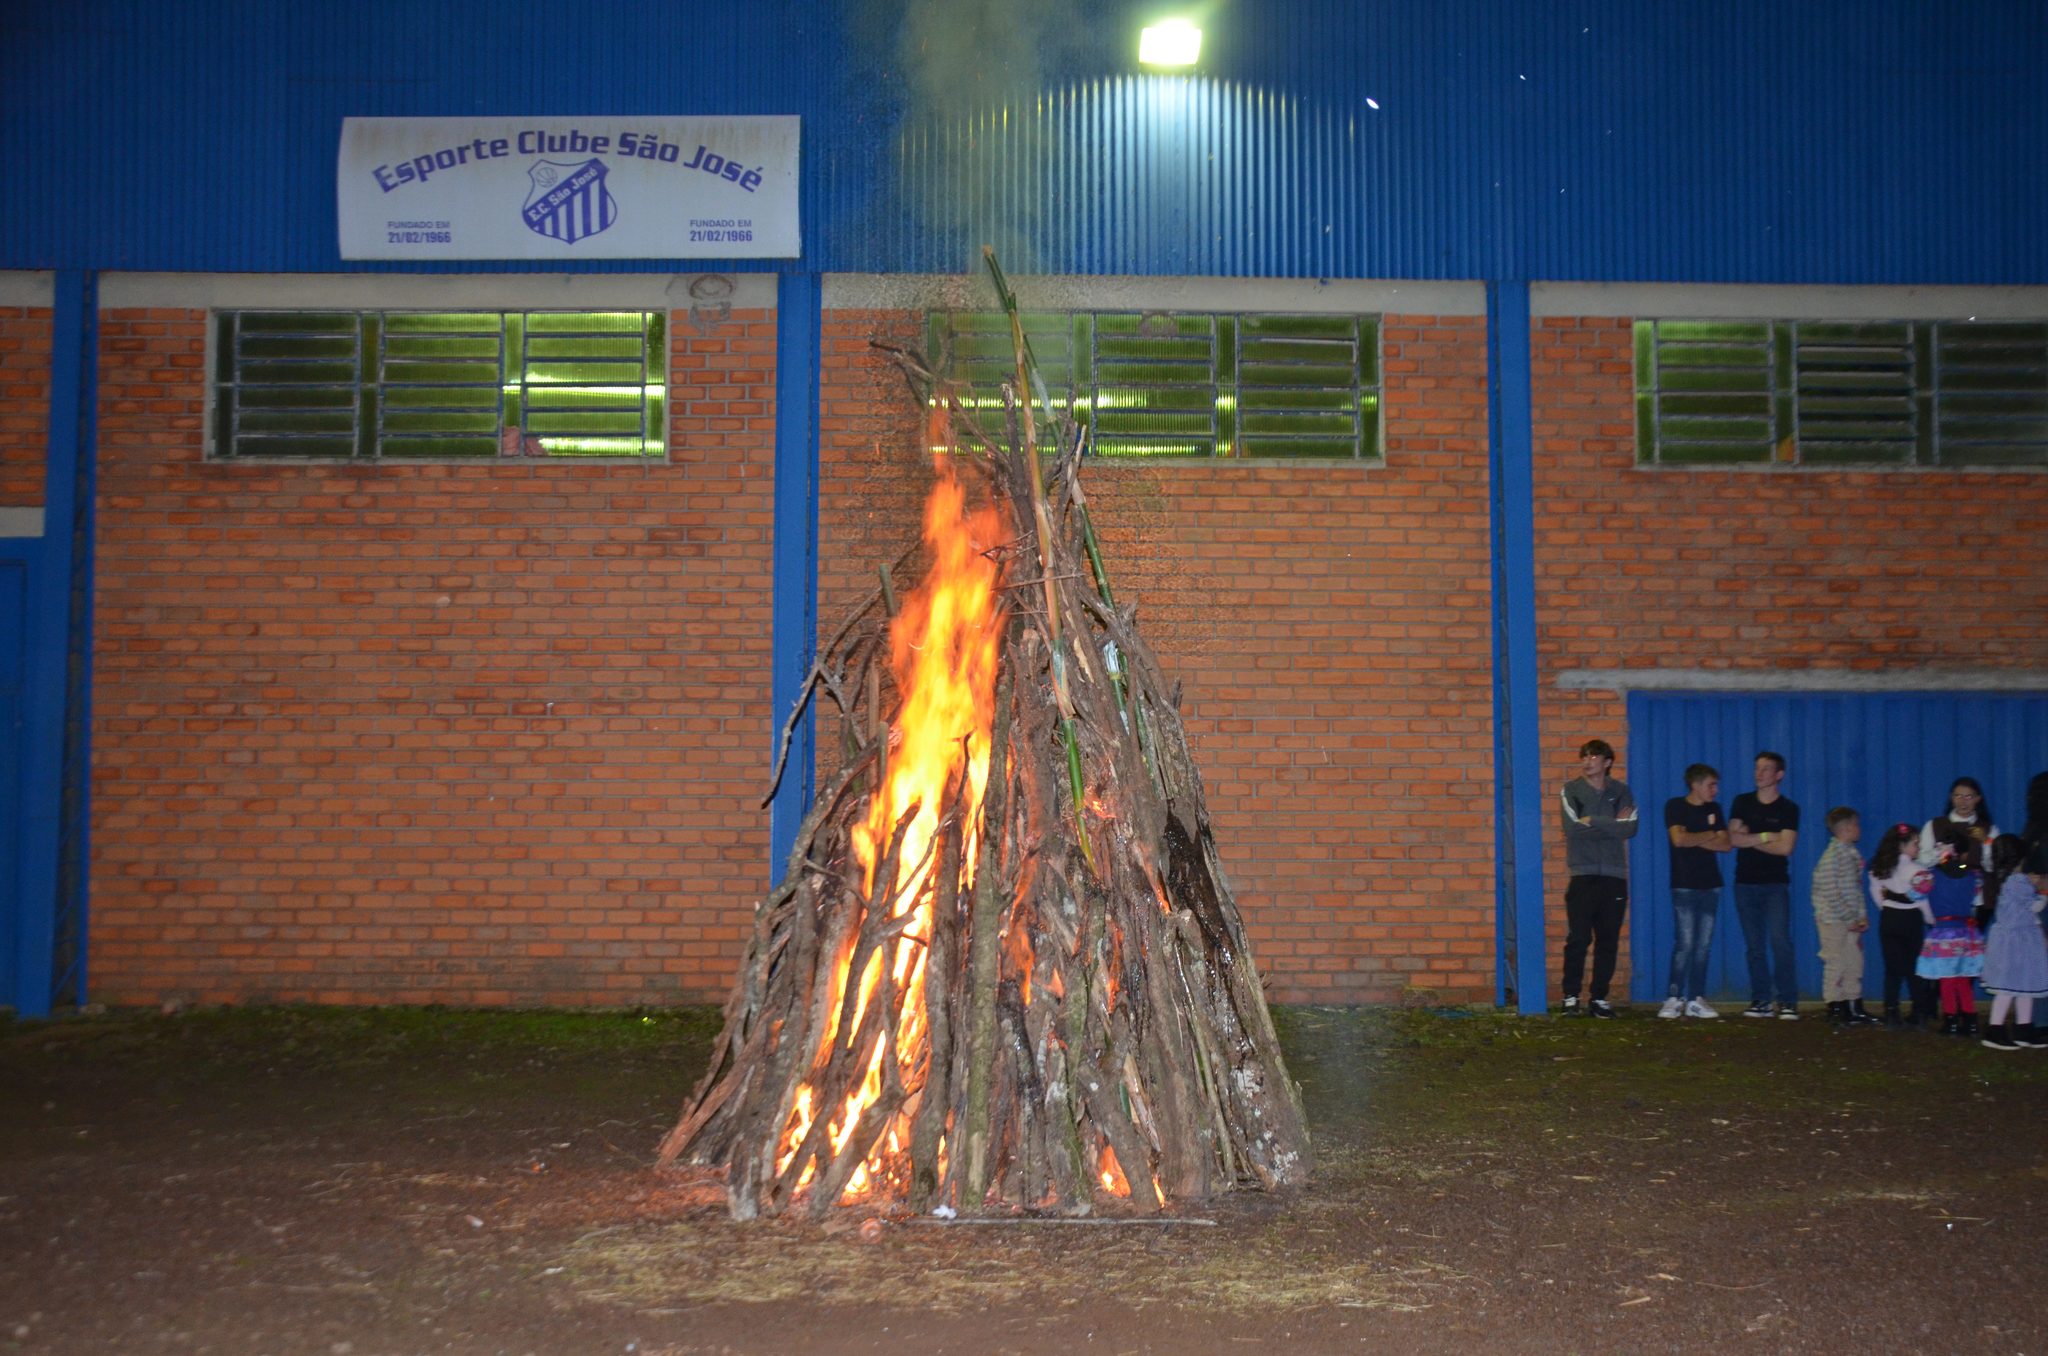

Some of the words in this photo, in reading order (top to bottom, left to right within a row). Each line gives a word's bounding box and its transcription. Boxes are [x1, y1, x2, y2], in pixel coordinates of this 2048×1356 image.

[372, 138, 509, 193] Esporte
[518, 130, 610, 154] Clube
[617, 132, 680, 163] São
[683, 145, 764, 193] José
[571, 167, 598, 190] José
[690, 219, 735, 227] FUNDADO
[737, 219, 752, 227] EM
[388, 231, 451, 243] 21/02/1966
[690, 230, 753, 241] 21/02/1966
